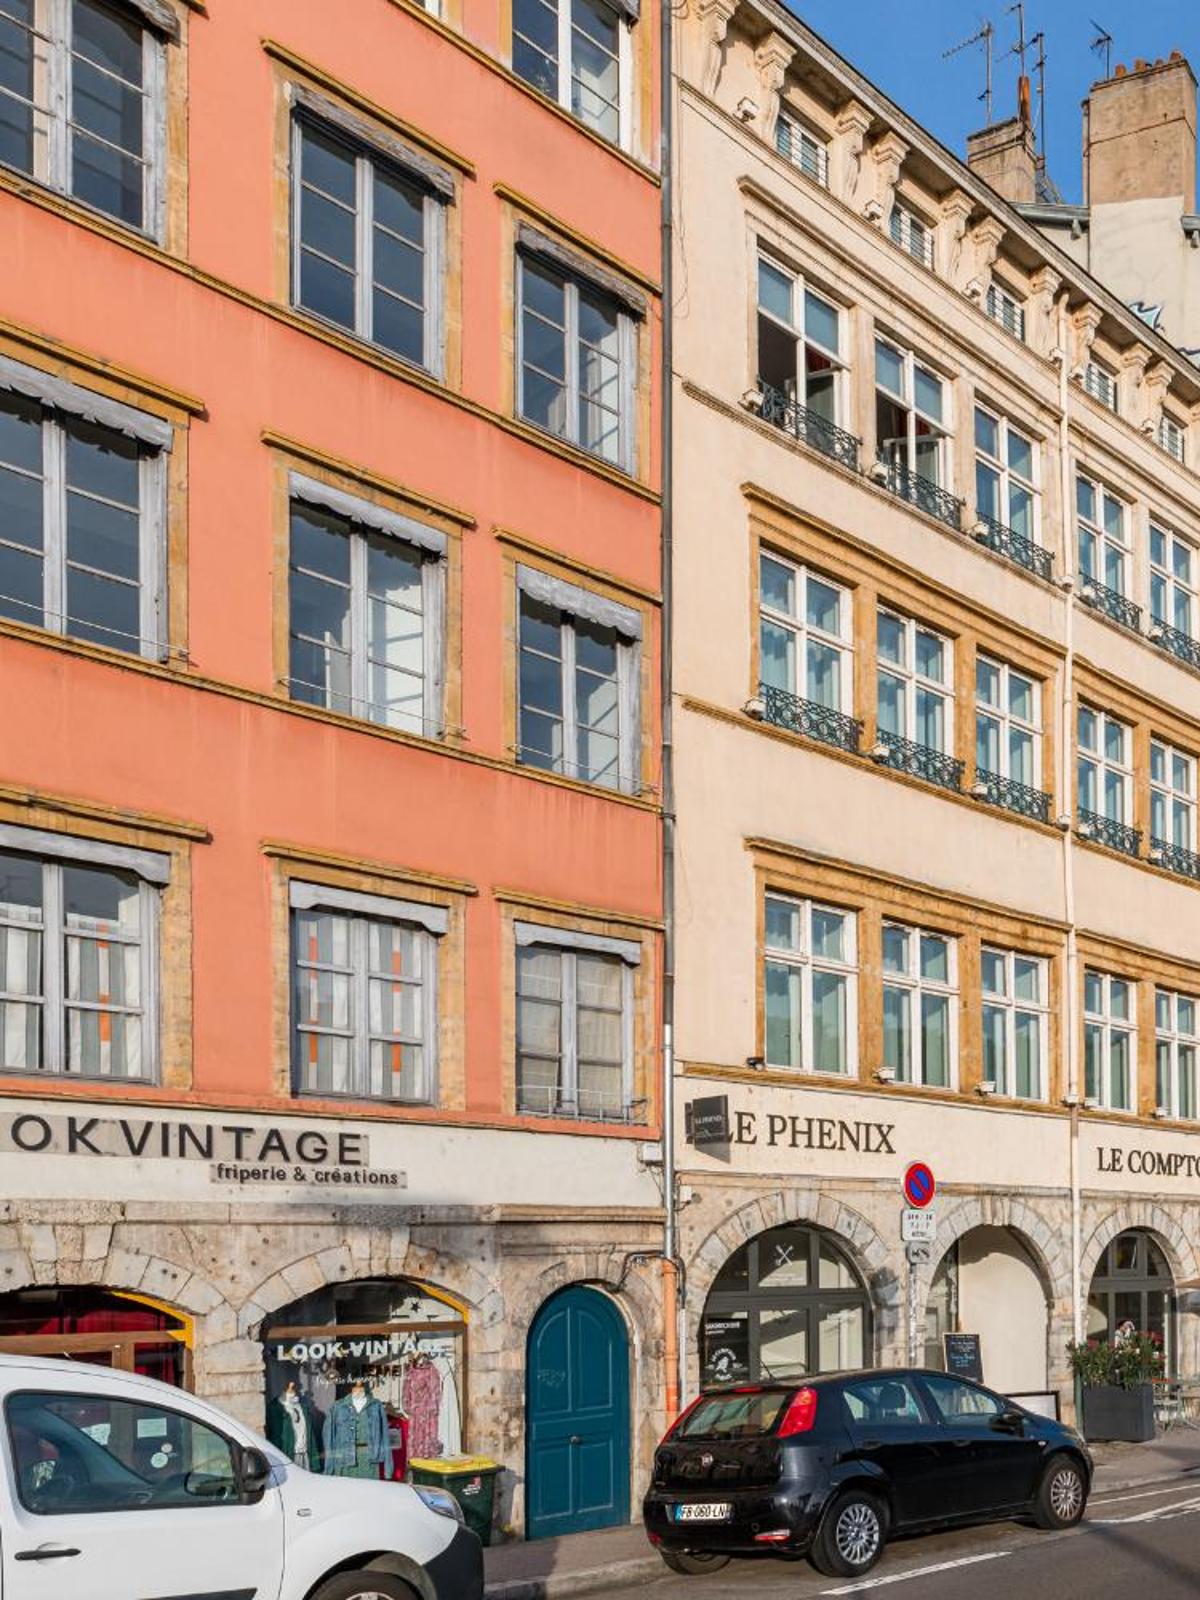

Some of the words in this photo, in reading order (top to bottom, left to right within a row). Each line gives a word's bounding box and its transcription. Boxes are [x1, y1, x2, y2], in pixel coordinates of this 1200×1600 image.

[11, 1114, 103, 1154] OK
[119, 1119, 364, 1166] VINTAGE
[729, 1111, 758, 1144] E
[766, 1114, 897, 1154] PHENIX
[1096, 1147, 1123, 1172] LE
[217, 1163, 287, 1183] friperie
[293, 1166, 307, 1183] &
[314, 1168, 399, 1186] créations
[277, 1342, 345, 1364] LOOK
